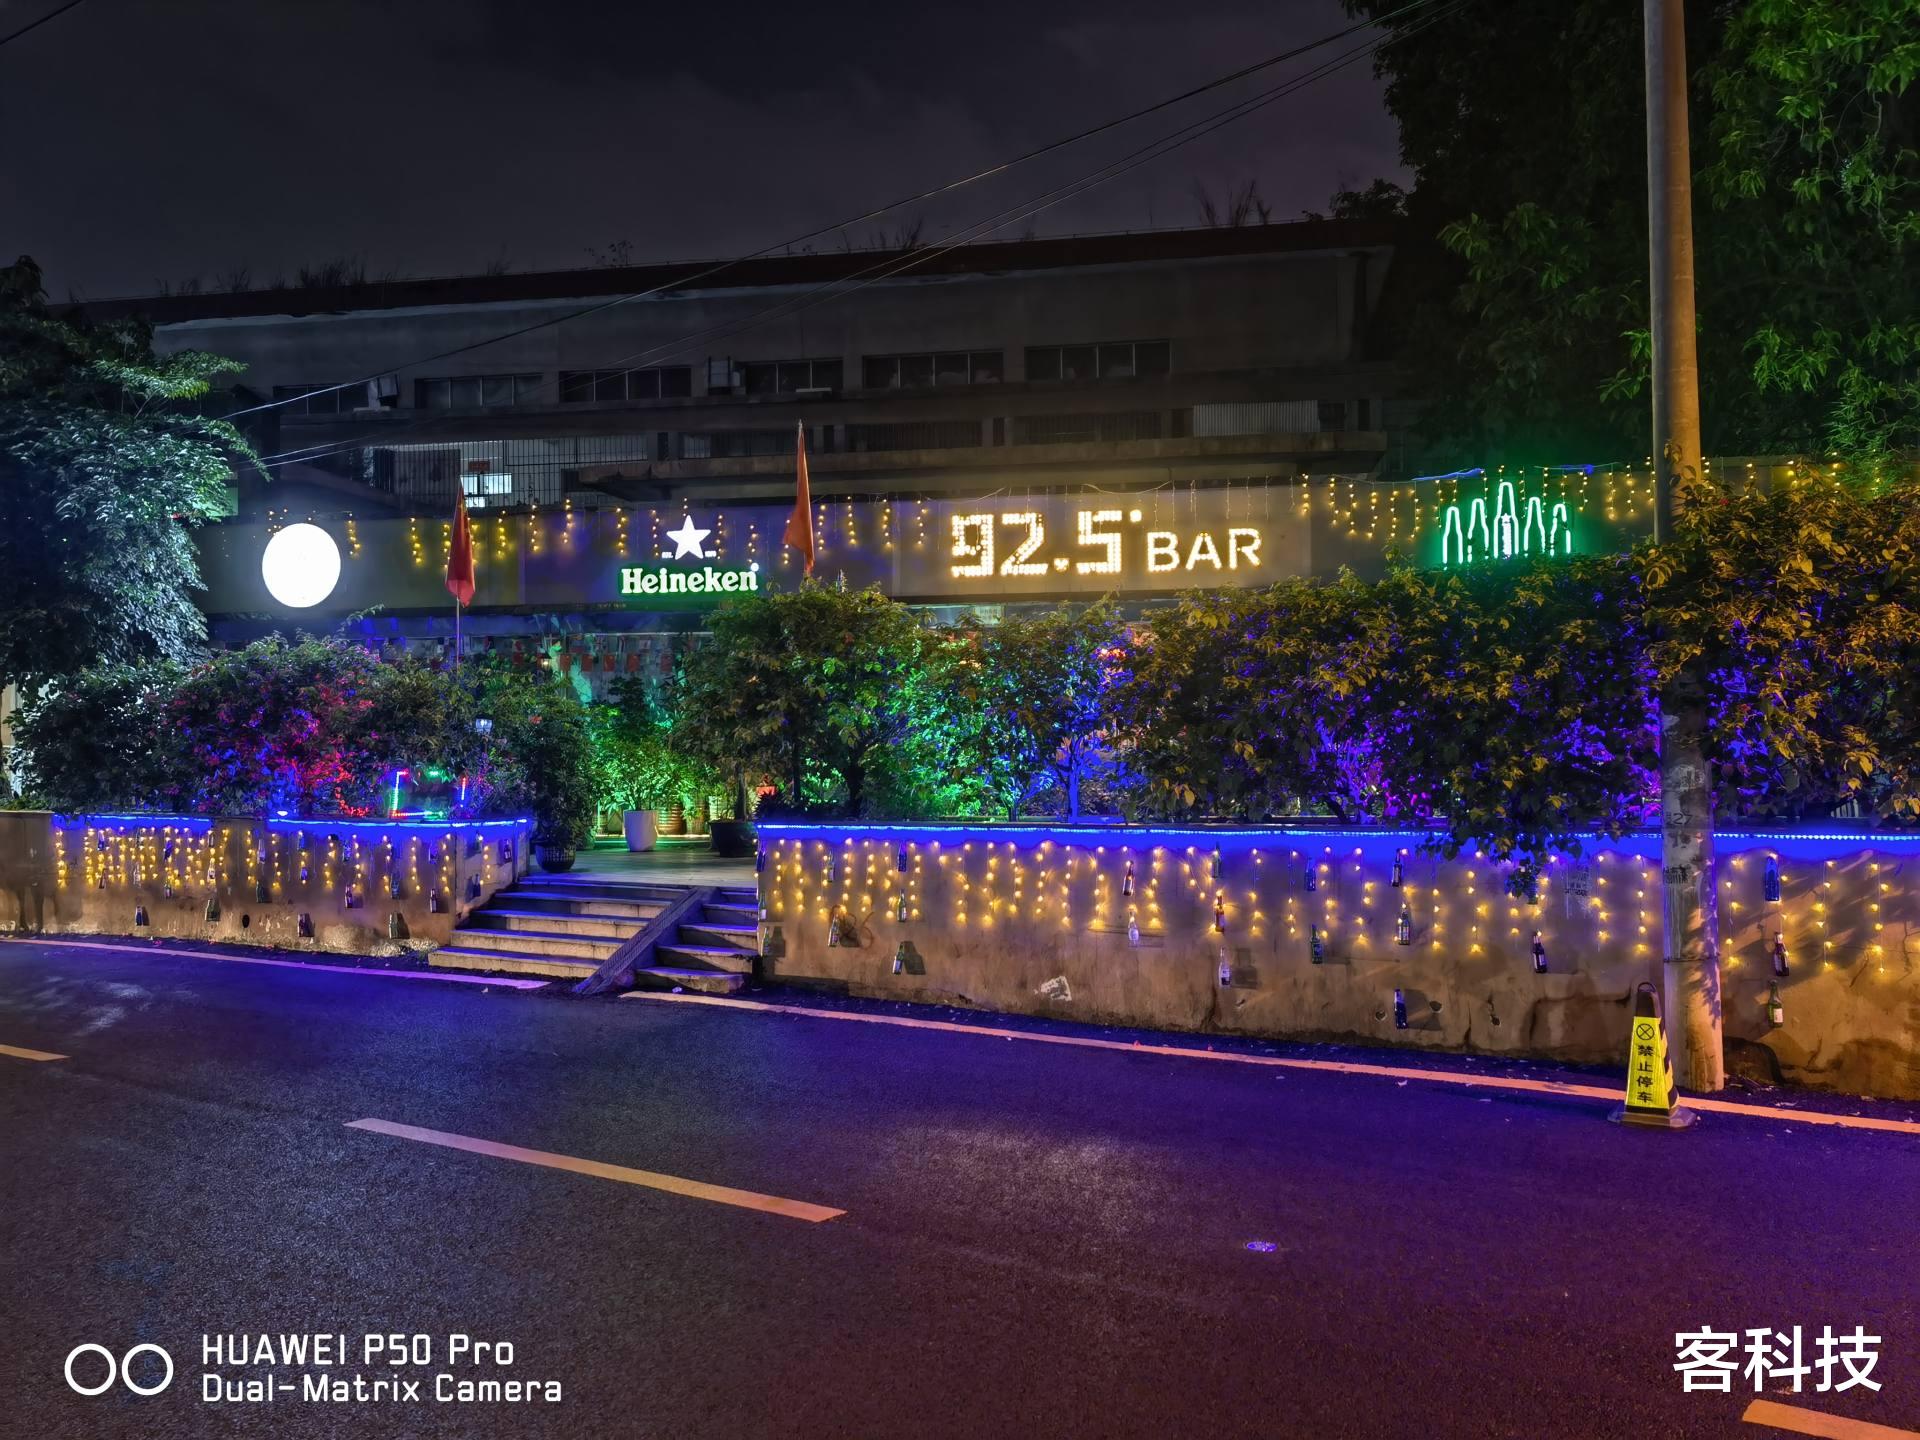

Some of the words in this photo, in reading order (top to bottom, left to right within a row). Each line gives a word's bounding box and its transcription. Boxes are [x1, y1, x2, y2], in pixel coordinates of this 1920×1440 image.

[1146, 527, 1263, 573] BAR
[621, 566, 758, 594] Heineken
[1636, 1044, 1654, 1103] 禁止停车
